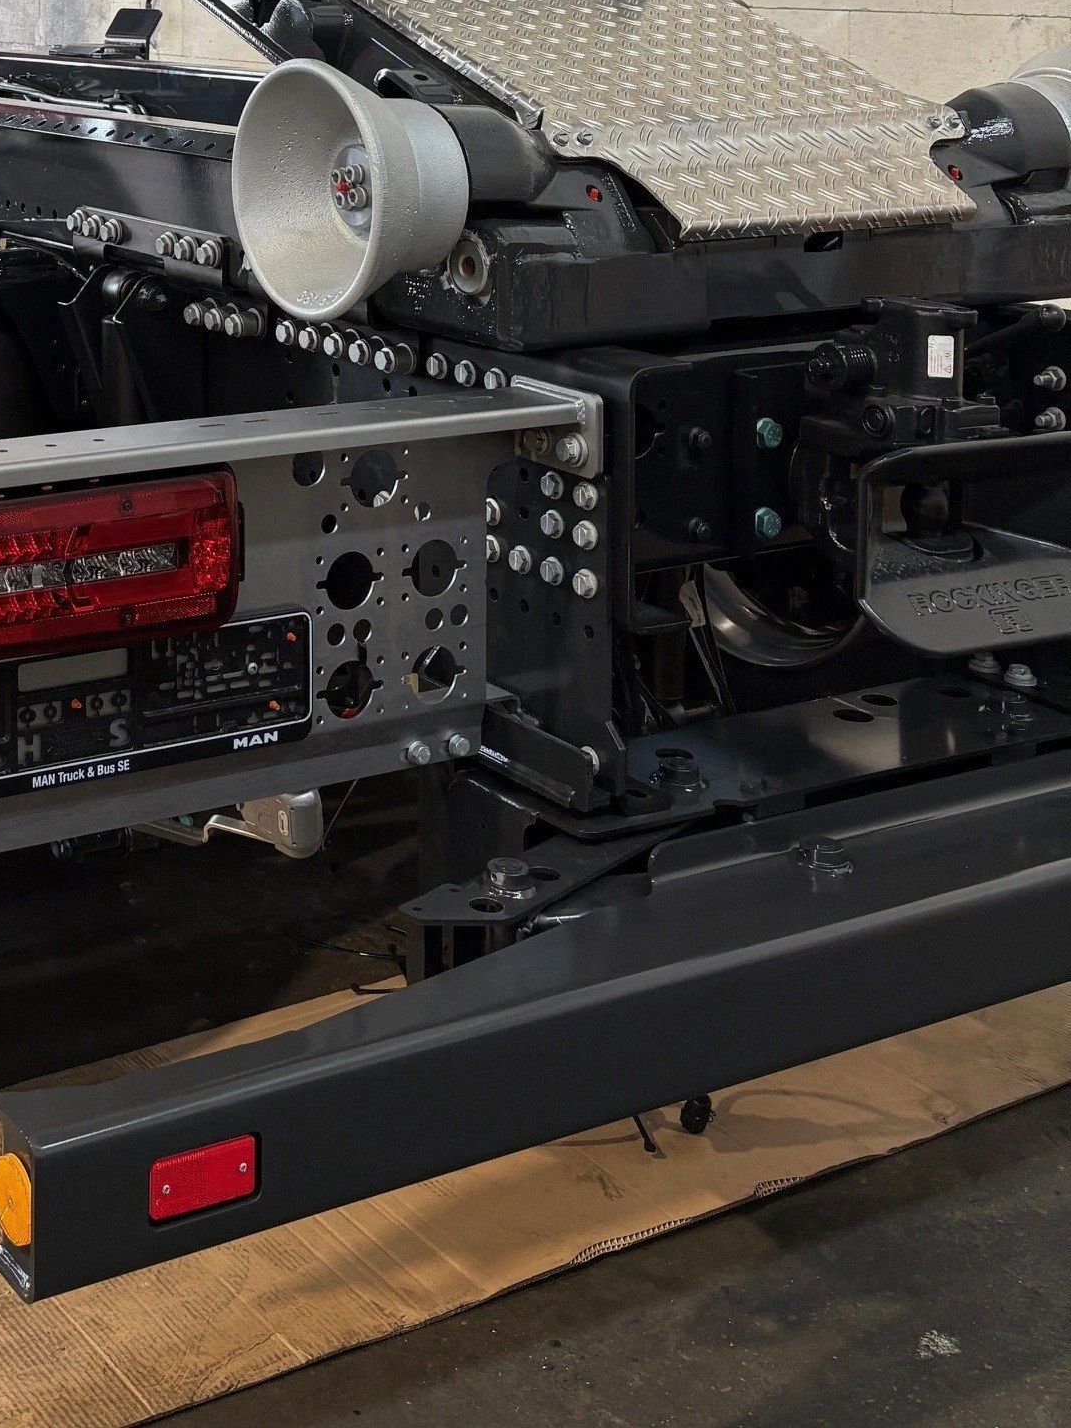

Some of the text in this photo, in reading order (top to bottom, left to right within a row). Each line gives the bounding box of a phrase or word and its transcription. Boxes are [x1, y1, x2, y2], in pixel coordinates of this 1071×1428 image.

[907, 574, 1070, 616] ROCKINGER
[233, 730, 278, 750] MAN
[32, 758, 130, 789] MAN Truck & Bus SE
